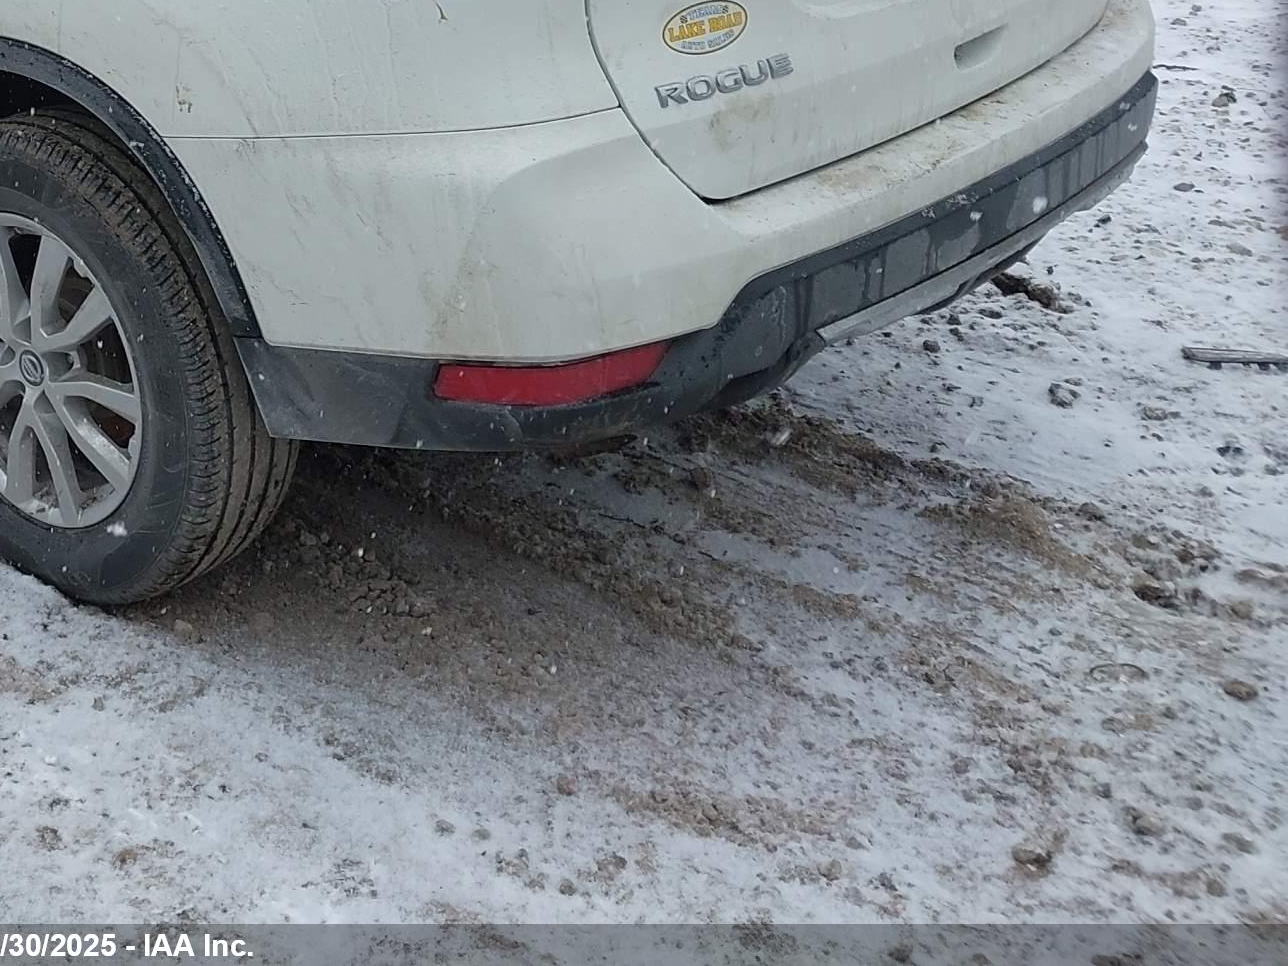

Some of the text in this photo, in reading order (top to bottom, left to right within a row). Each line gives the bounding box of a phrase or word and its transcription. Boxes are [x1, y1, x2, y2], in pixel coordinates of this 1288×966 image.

[668, 11, 743, 42] LAKE ROAD
[654, 53, 794, 109] ROGUE
